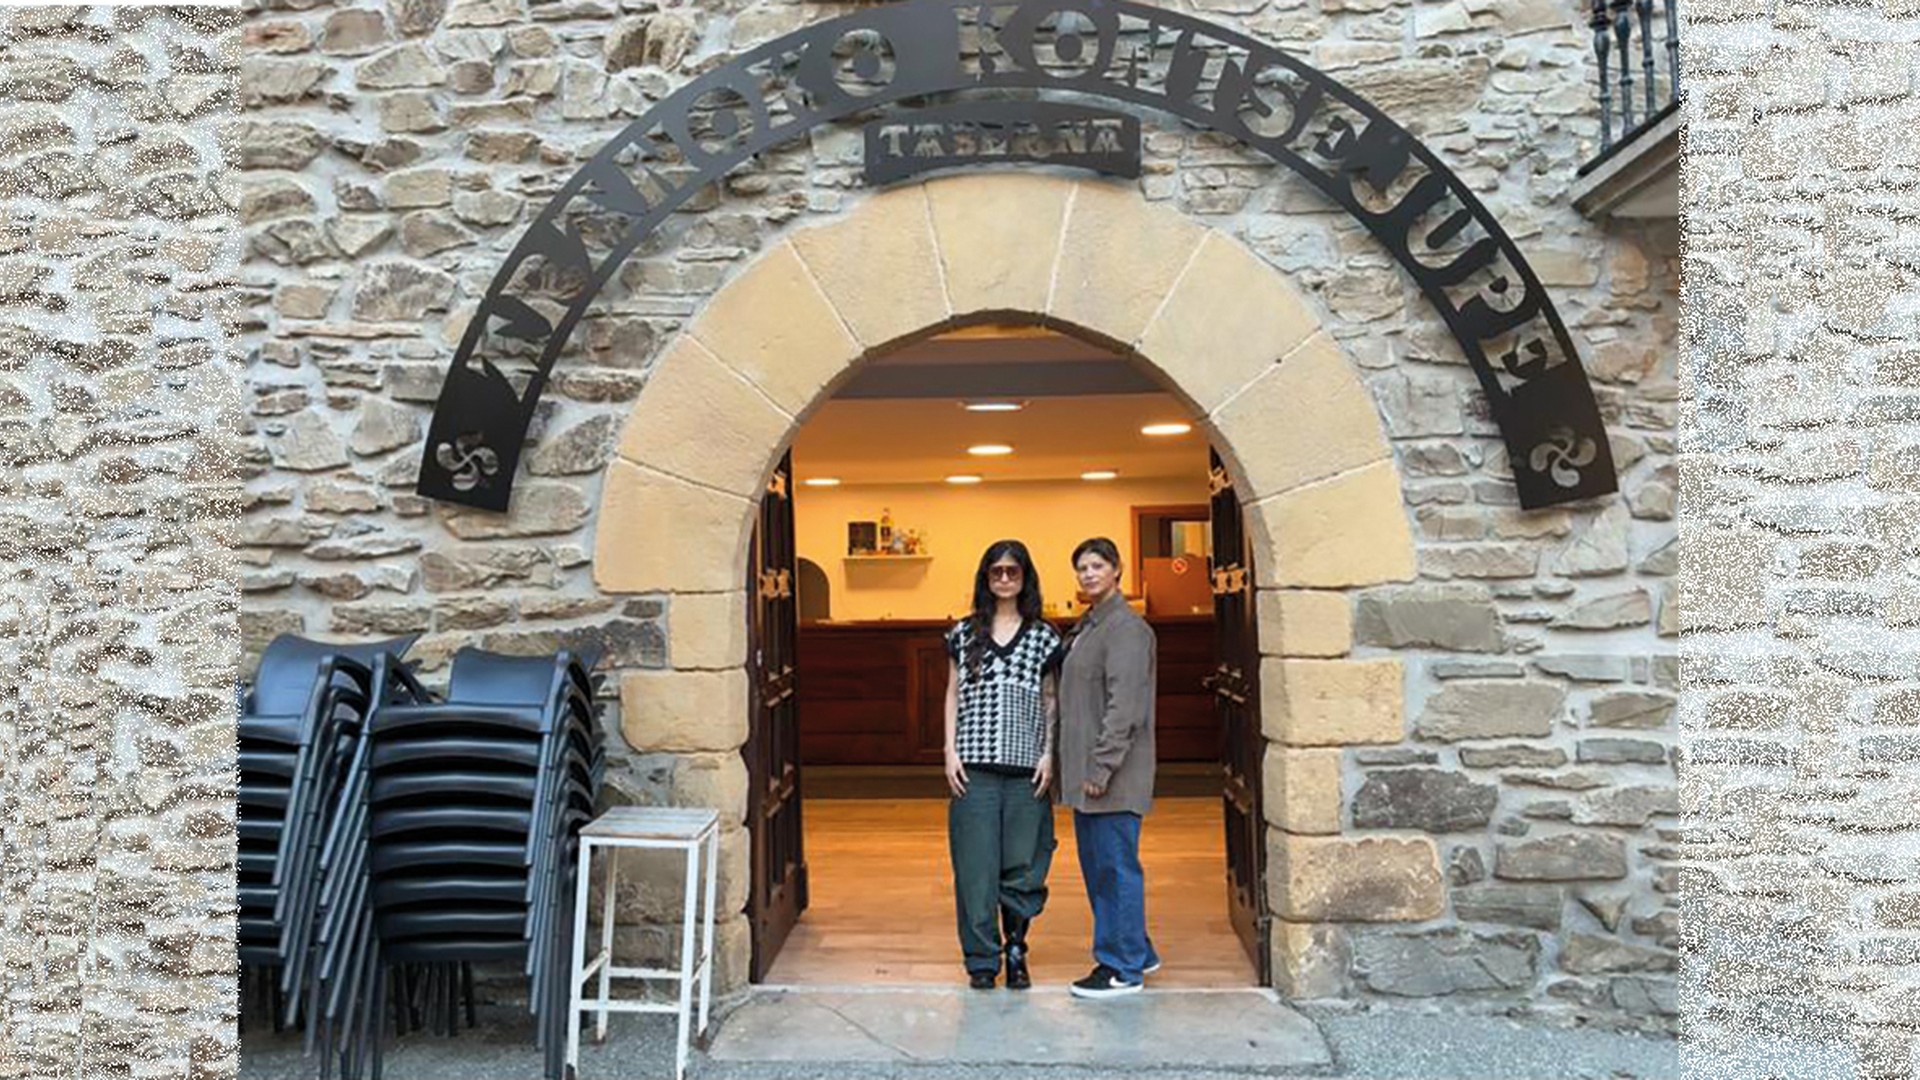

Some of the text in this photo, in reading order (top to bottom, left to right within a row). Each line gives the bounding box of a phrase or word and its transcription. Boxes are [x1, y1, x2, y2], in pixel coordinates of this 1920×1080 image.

[466, 5, 1568, 403] ARANOKO KONTSEJUPE
[879, 119, 1124, 158] TABERNA
